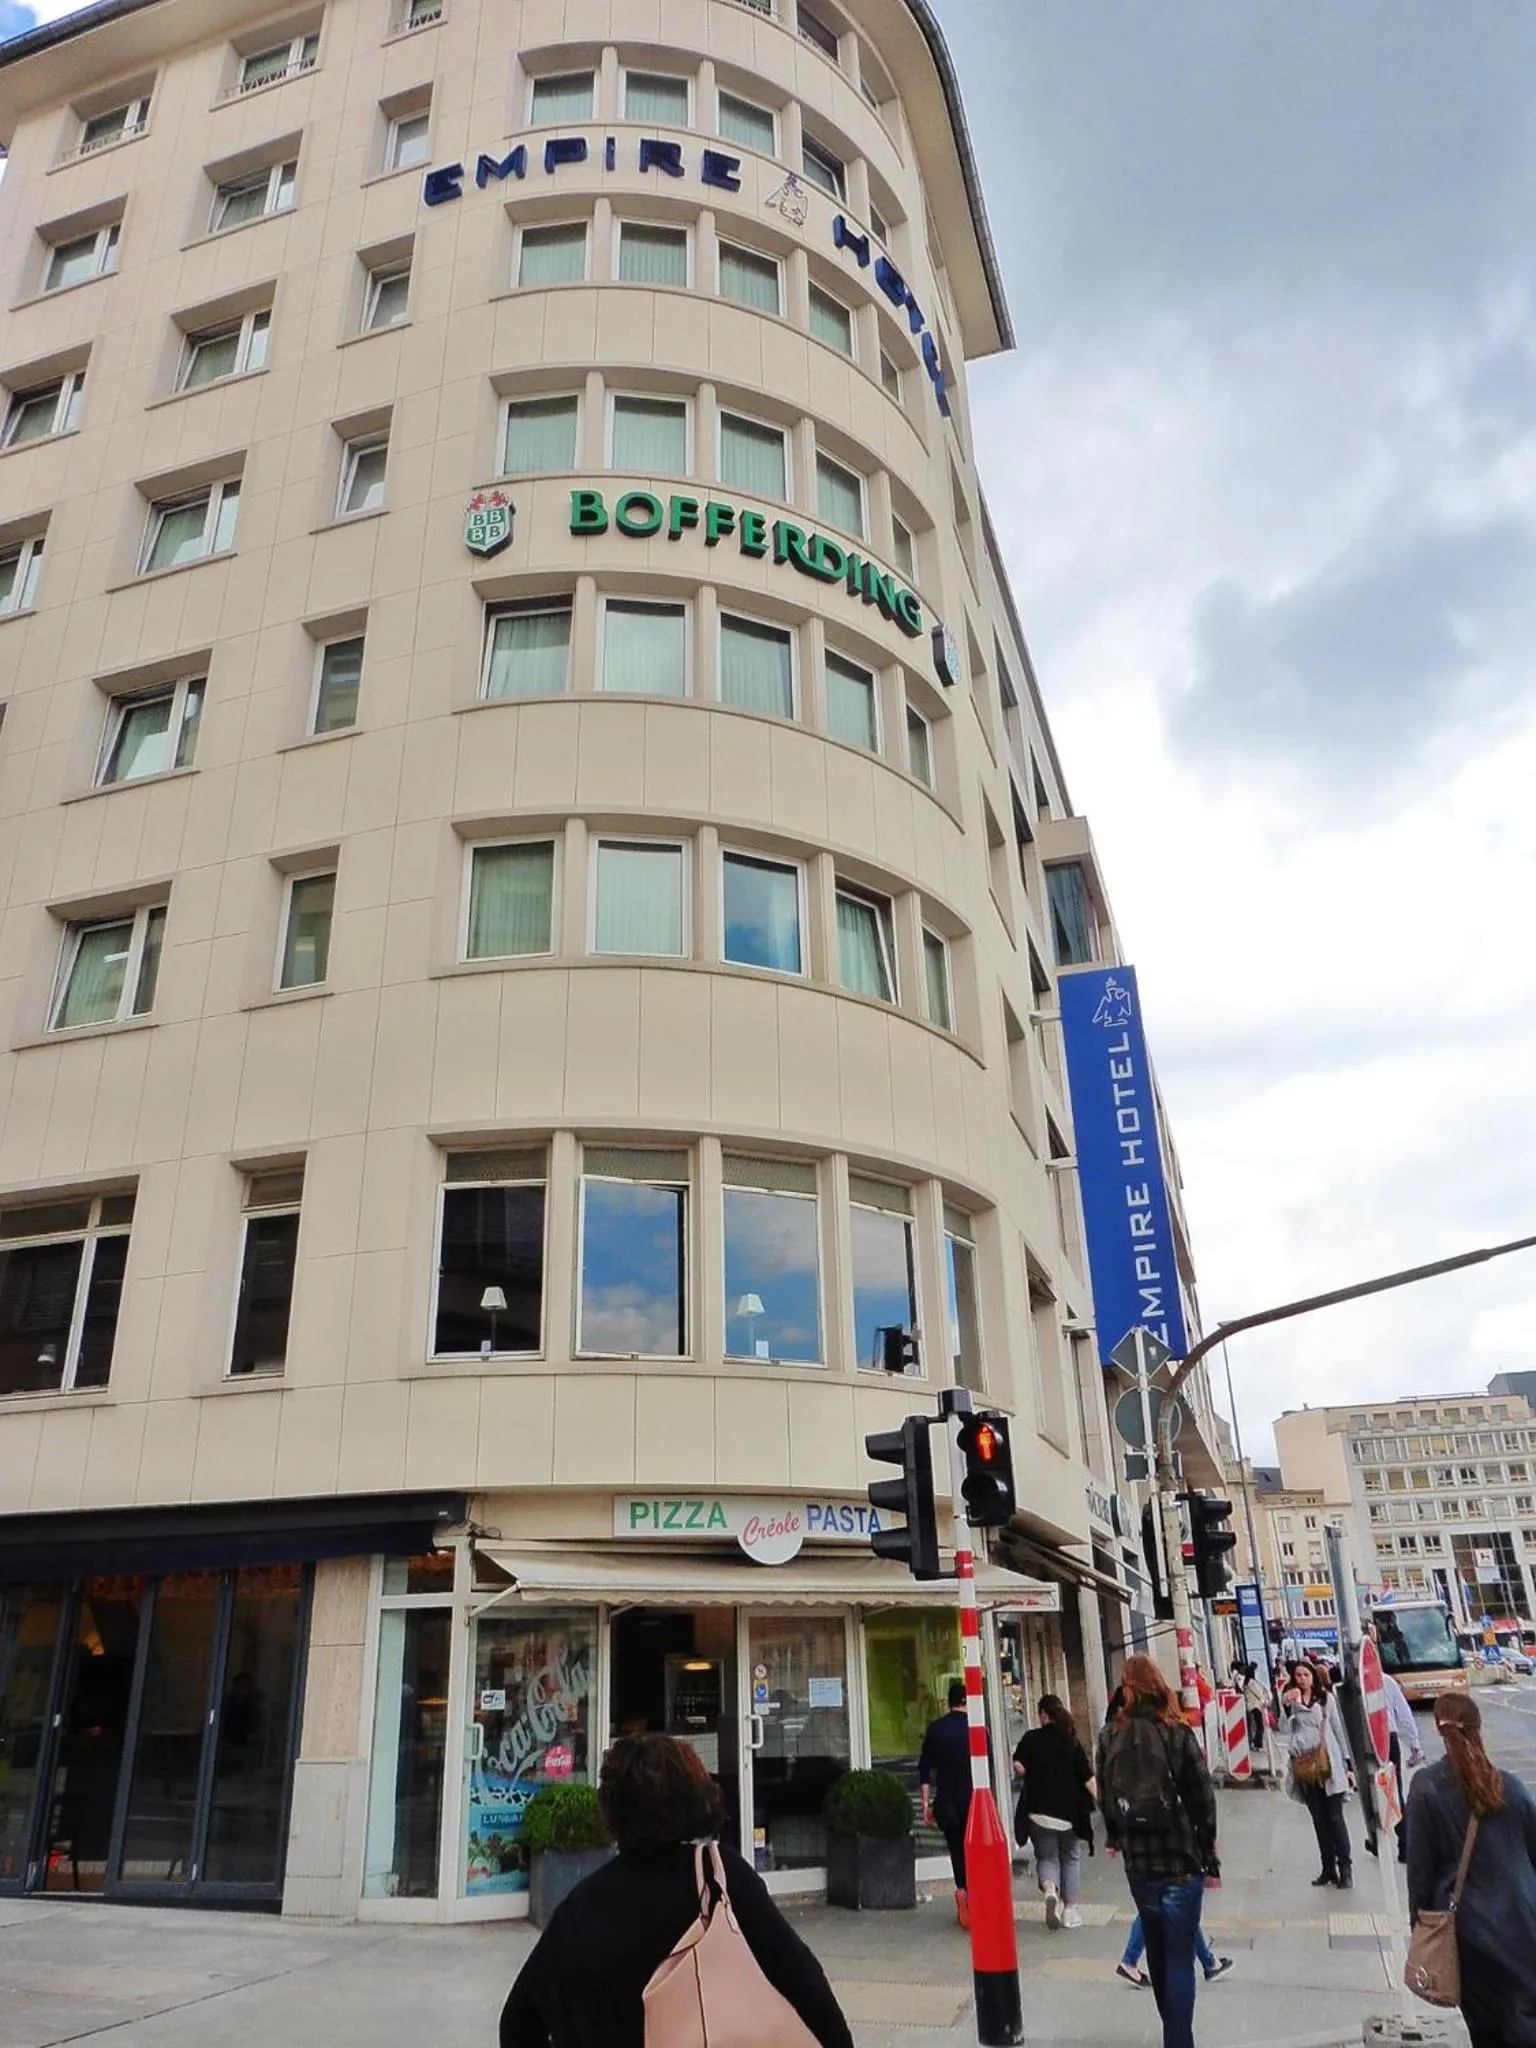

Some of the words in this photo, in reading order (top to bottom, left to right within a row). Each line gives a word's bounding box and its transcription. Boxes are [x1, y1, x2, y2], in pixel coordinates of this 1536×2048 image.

[423, 136, 741, 207] EMPIRE
[832, 214, 951, 418] HOTEL
[569, 488, 925, 639] BOFFERDING
[1107, 1031, 1145, 1167] HOTEL
[630, 1501, 727, 1530] PIZZA
[743, 1511, 800, 1547] Créole
[806, 1504, 882, 1534] PASTA
